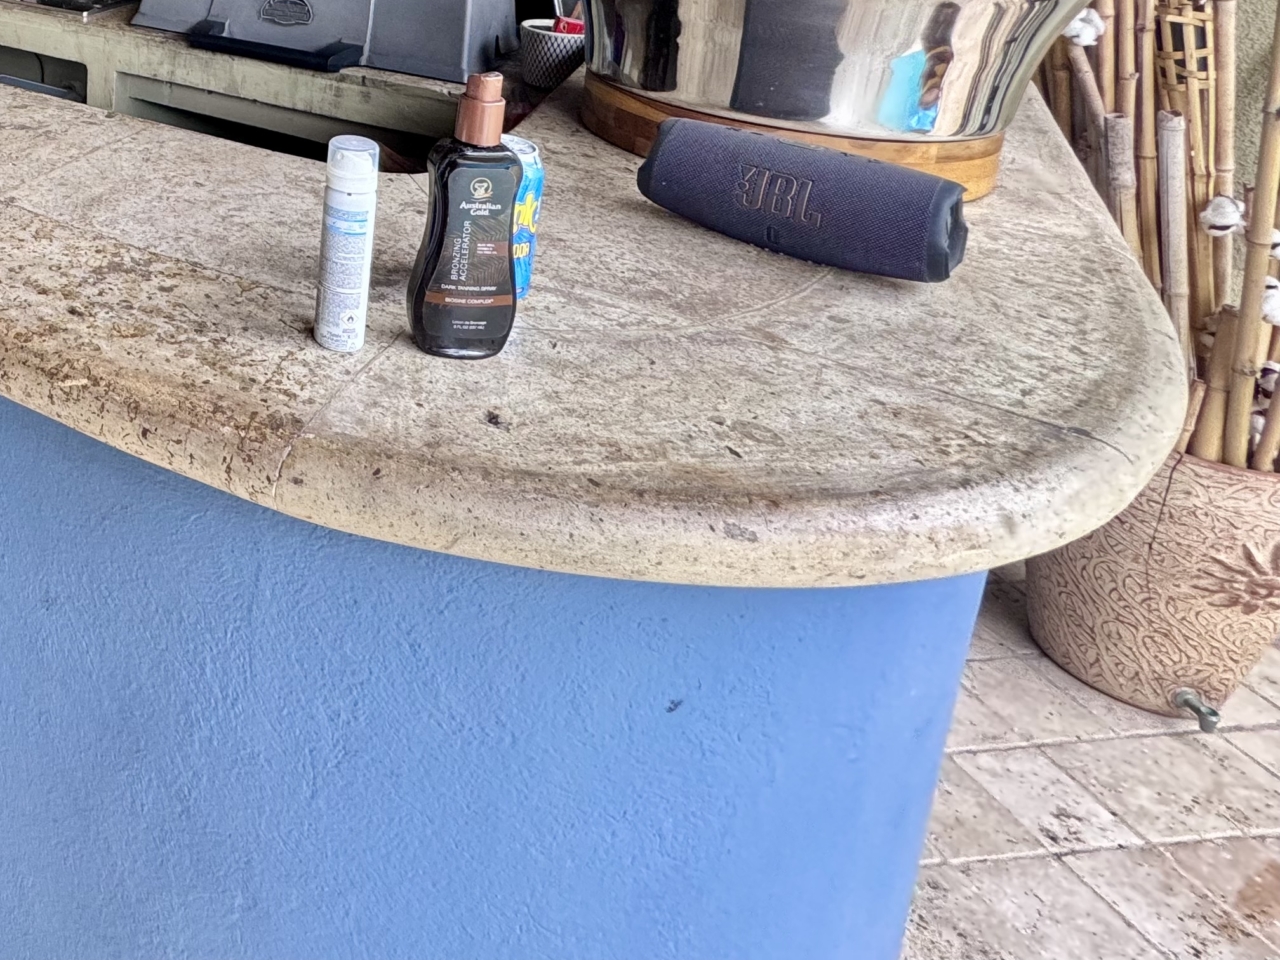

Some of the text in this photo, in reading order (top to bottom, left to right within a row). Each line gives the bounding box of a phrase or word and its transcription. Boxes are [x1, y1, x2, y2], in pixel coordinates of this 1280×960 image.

[459, 201, 502, 210] Australian
[734, 164, 821, 228] JBL
[451, 238, 461, 280] BRONZING
[459, 221, 472, 281] ACCELERATOR
